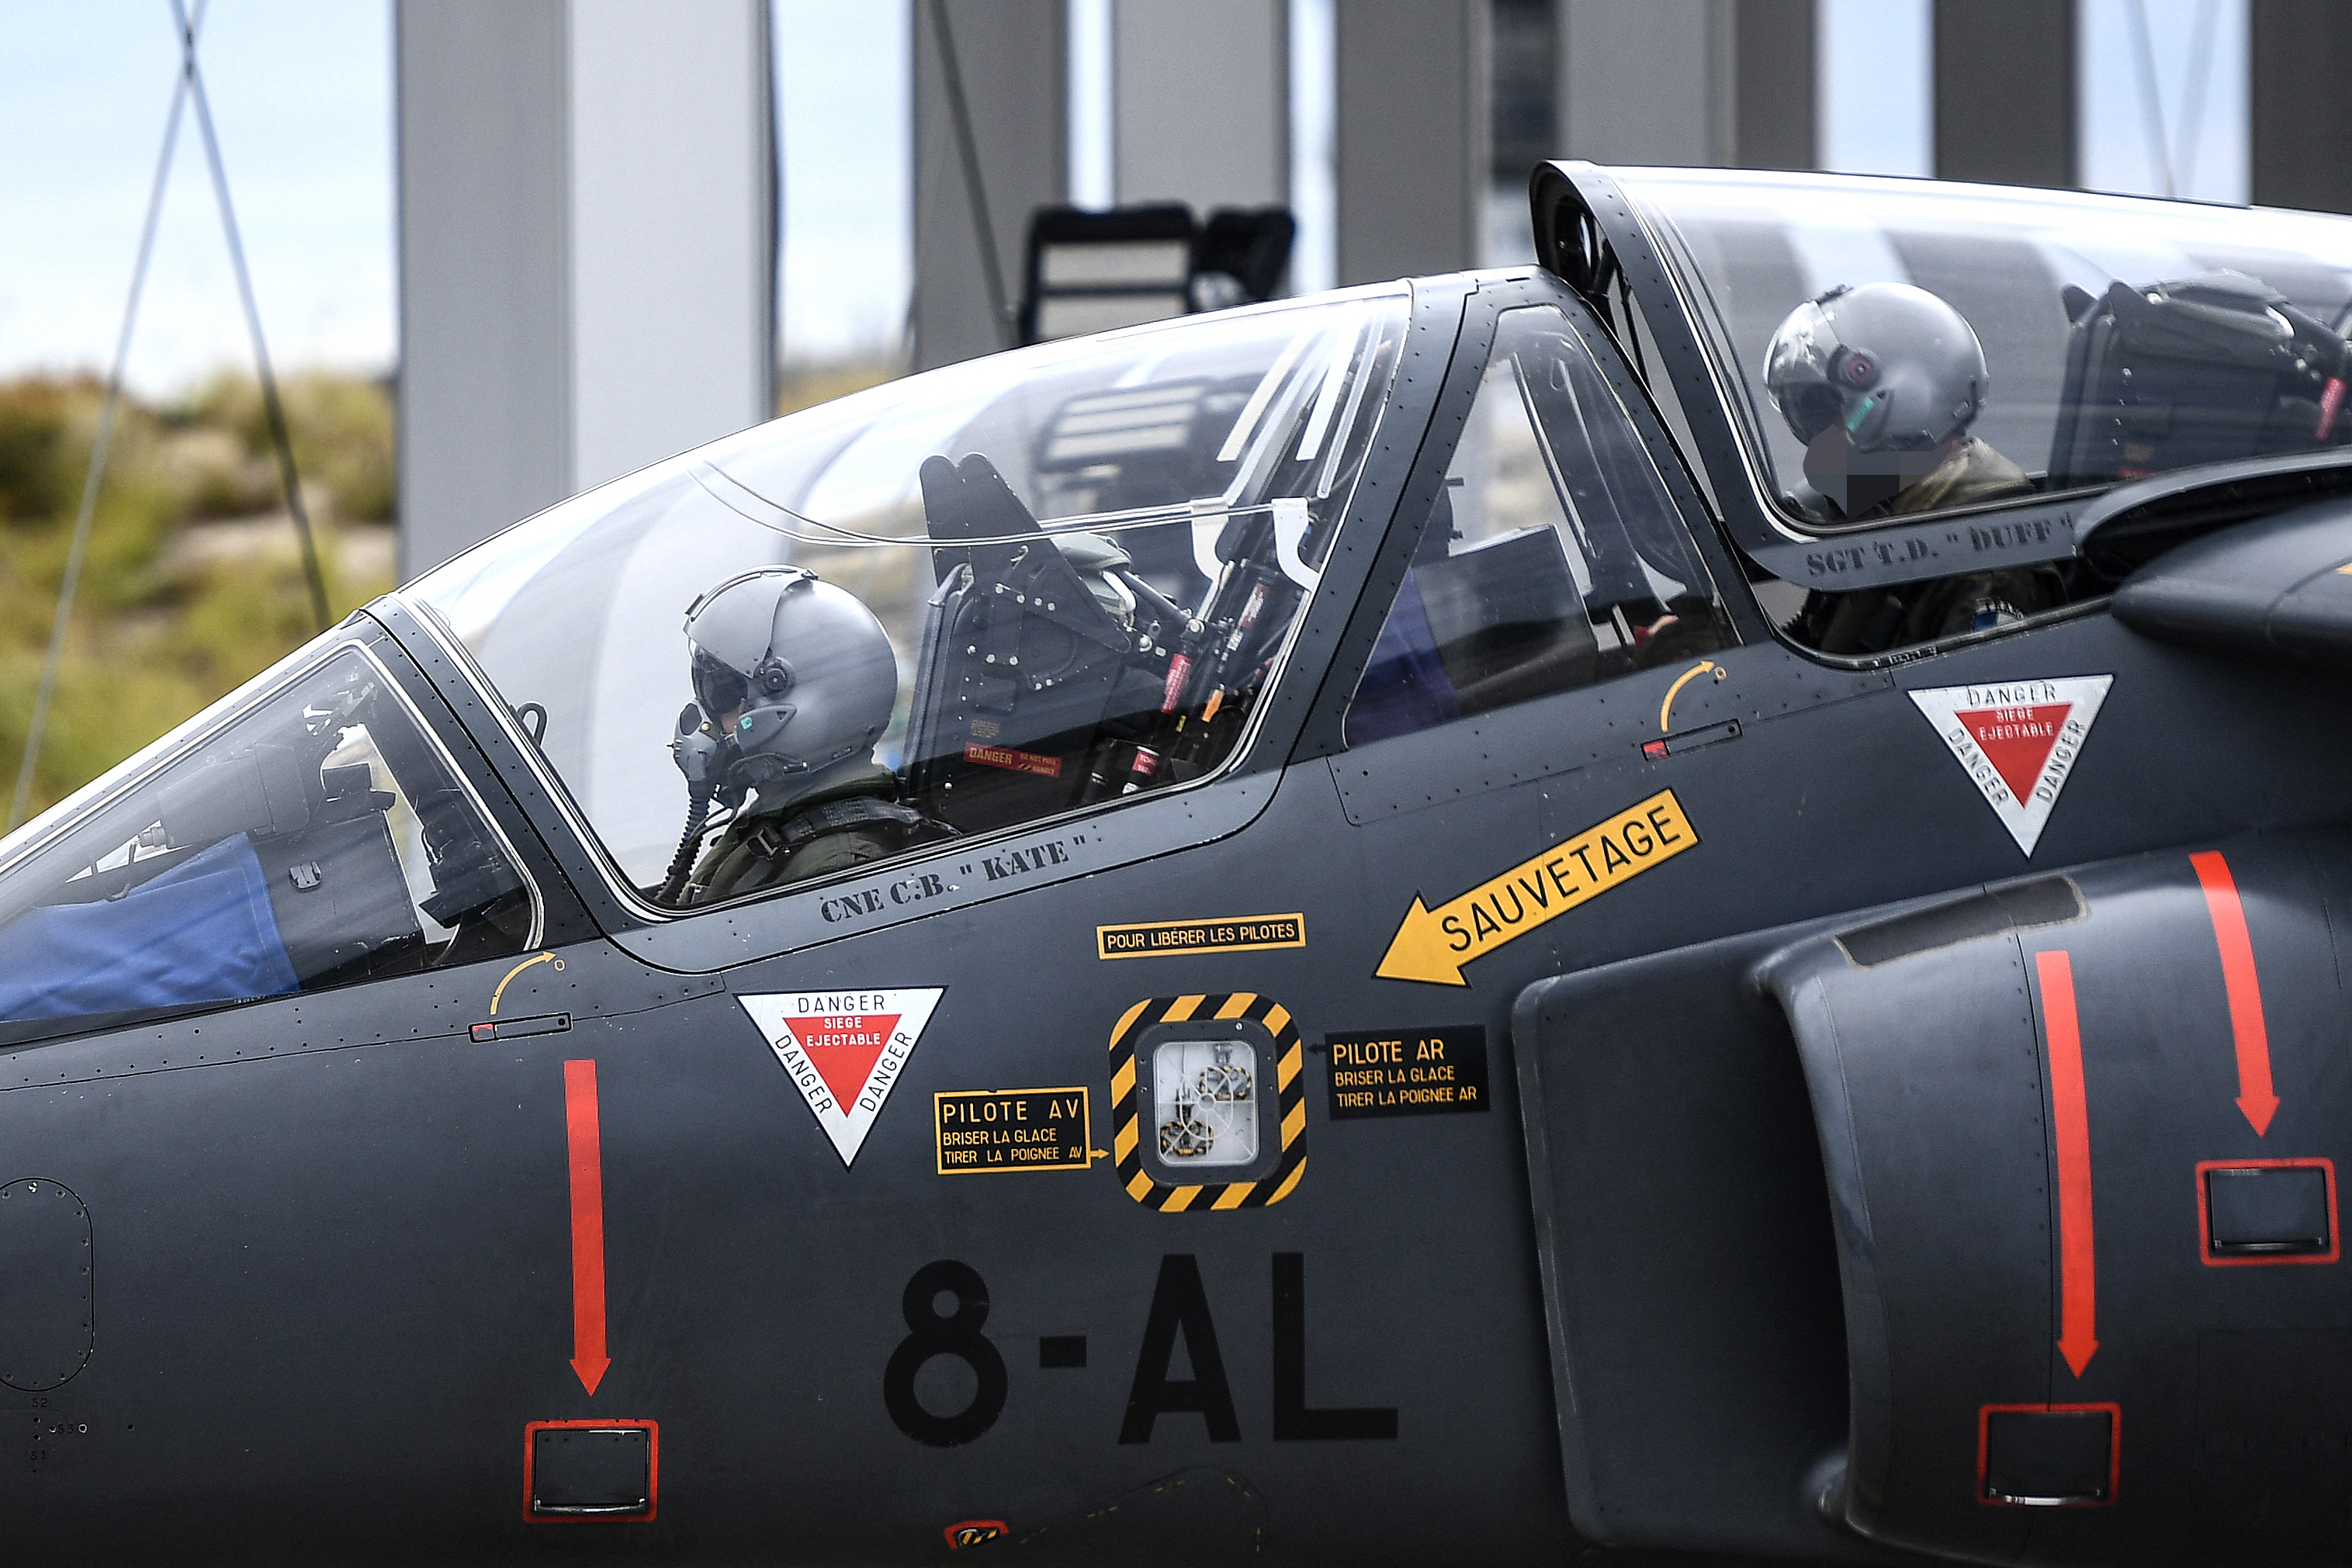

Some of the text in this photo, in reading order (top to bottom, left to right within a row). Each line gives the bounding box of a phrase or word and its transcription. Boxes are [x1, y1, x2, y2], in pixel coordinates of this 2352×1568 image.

[1806, 549, 1865, 576] SGT
[1873, 538, 1938, 564] T.D.
[1968, 682, 2057, 706] DANGER
[1996, 708, 2034, 722] SIEGE
[1979, 722, 2055, 741] EJECTABLE
[969, 747, 1013, 765] DANGER
[1948, 727, 2009, 806] DANGER
[2036, 719, 2085, 804] DANGER
[1442, 805, 1681, 951] SAUVETAGE
[821, 888, 885, 922] CNE
[1107, 923, 1295, 950] POUR LIBÉRER LES PILOTES
[798, 995, 885, 1013] DANGER
[824, 1016, 862, 1030] SIEGE
[806, 1033, 881, 1047] EJECTABLE
[1332, 1039, 1445, 1066] PILOTE AR
[775, 1034, 833, 1114] DANGER
[860, 1031, 913, 1112] DANGER
[1335, 1065, 1455, 1087] BRISER LA GLACE
[1337, 1085, 1477, 1108] TIRER LA POIGNEE AR
[944, 1099, 1079, 1123] PILOTE AV
[943, 1128, 1057, 1146] BRISER LA GLACE
[944, 1146, 1082, 1165] TIRER LA POIGNEE AV
[883, 1251, 1398, 1448] 8-AL
